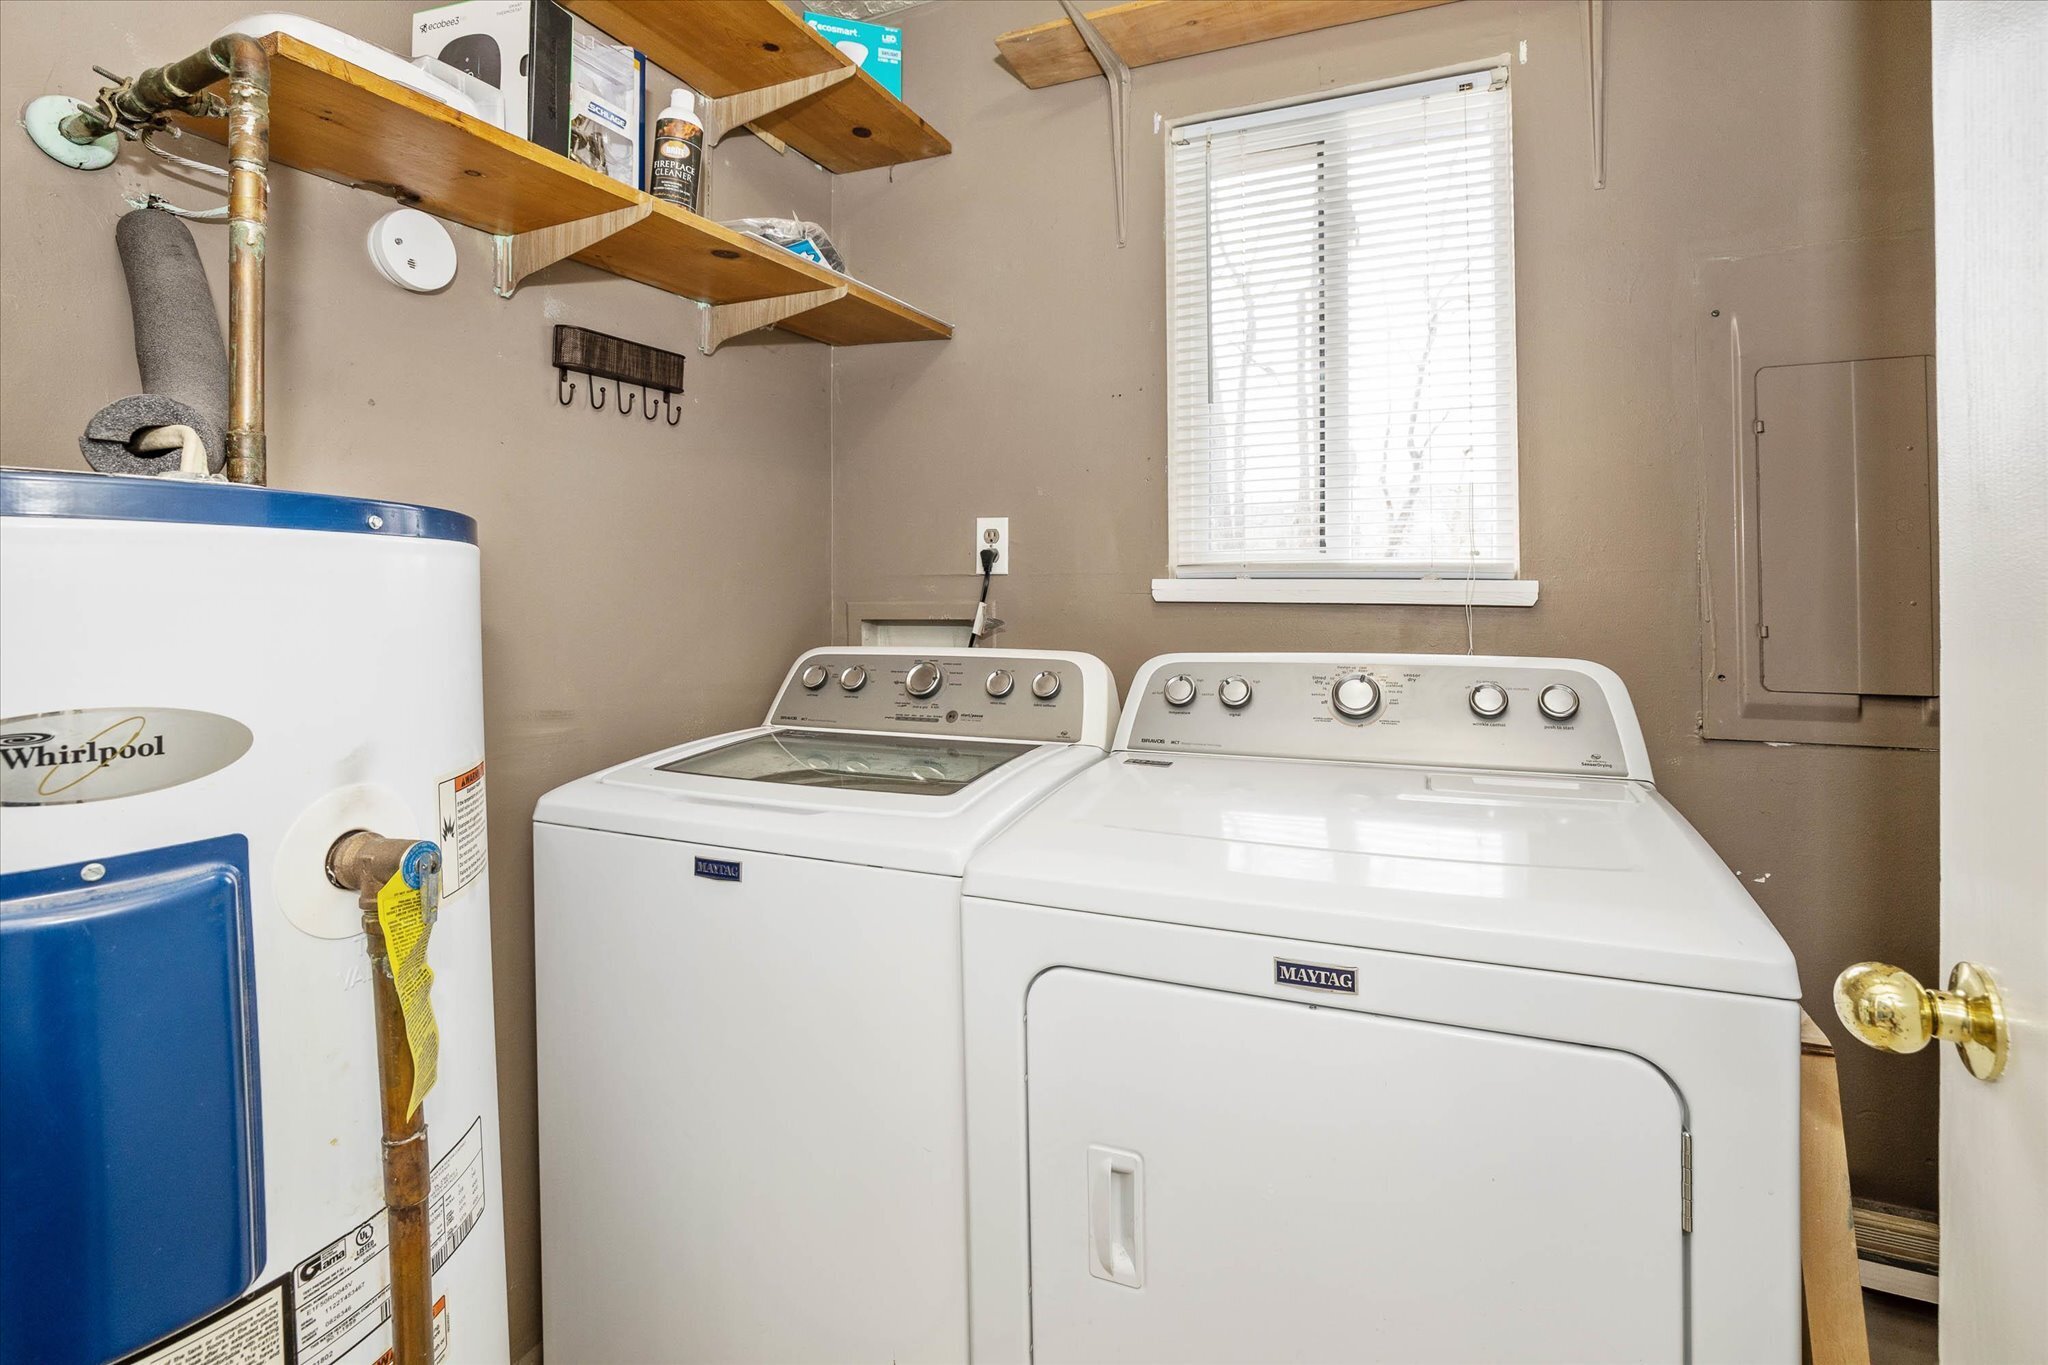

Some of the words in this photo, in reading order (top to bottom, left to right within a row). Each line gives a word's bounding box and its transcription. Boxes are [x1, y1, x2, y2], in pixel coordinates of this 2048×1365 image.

[428, 16, 460, 31] ecobee3
[817, 23, 858, 37] ecosmart
[882, 34, 897, 44] LED
[588, 103, 626, 127] SCHLAGE
[654, 160, 695, 176] FIREPLACE
[655, 168, 692, 182] CLEANER
[0, 735, 165, 770] Whirlpool
[697, 861, 738, 877] MAYTAG
[1280, 965, 1352, 988] MAYTAG
[356, 1240, 375, 1256] LISTED
[215, 1315, 253, 1340] connections
[256, 1307, 266, 1316] will
[268, 1301, 278, 1309] not
[231, 1326, 258, 1344] extended
[260, 1313, 278, 1328] period
[265, 1320, 278, 1331] early
[250, 1332, 279, 1352] location
